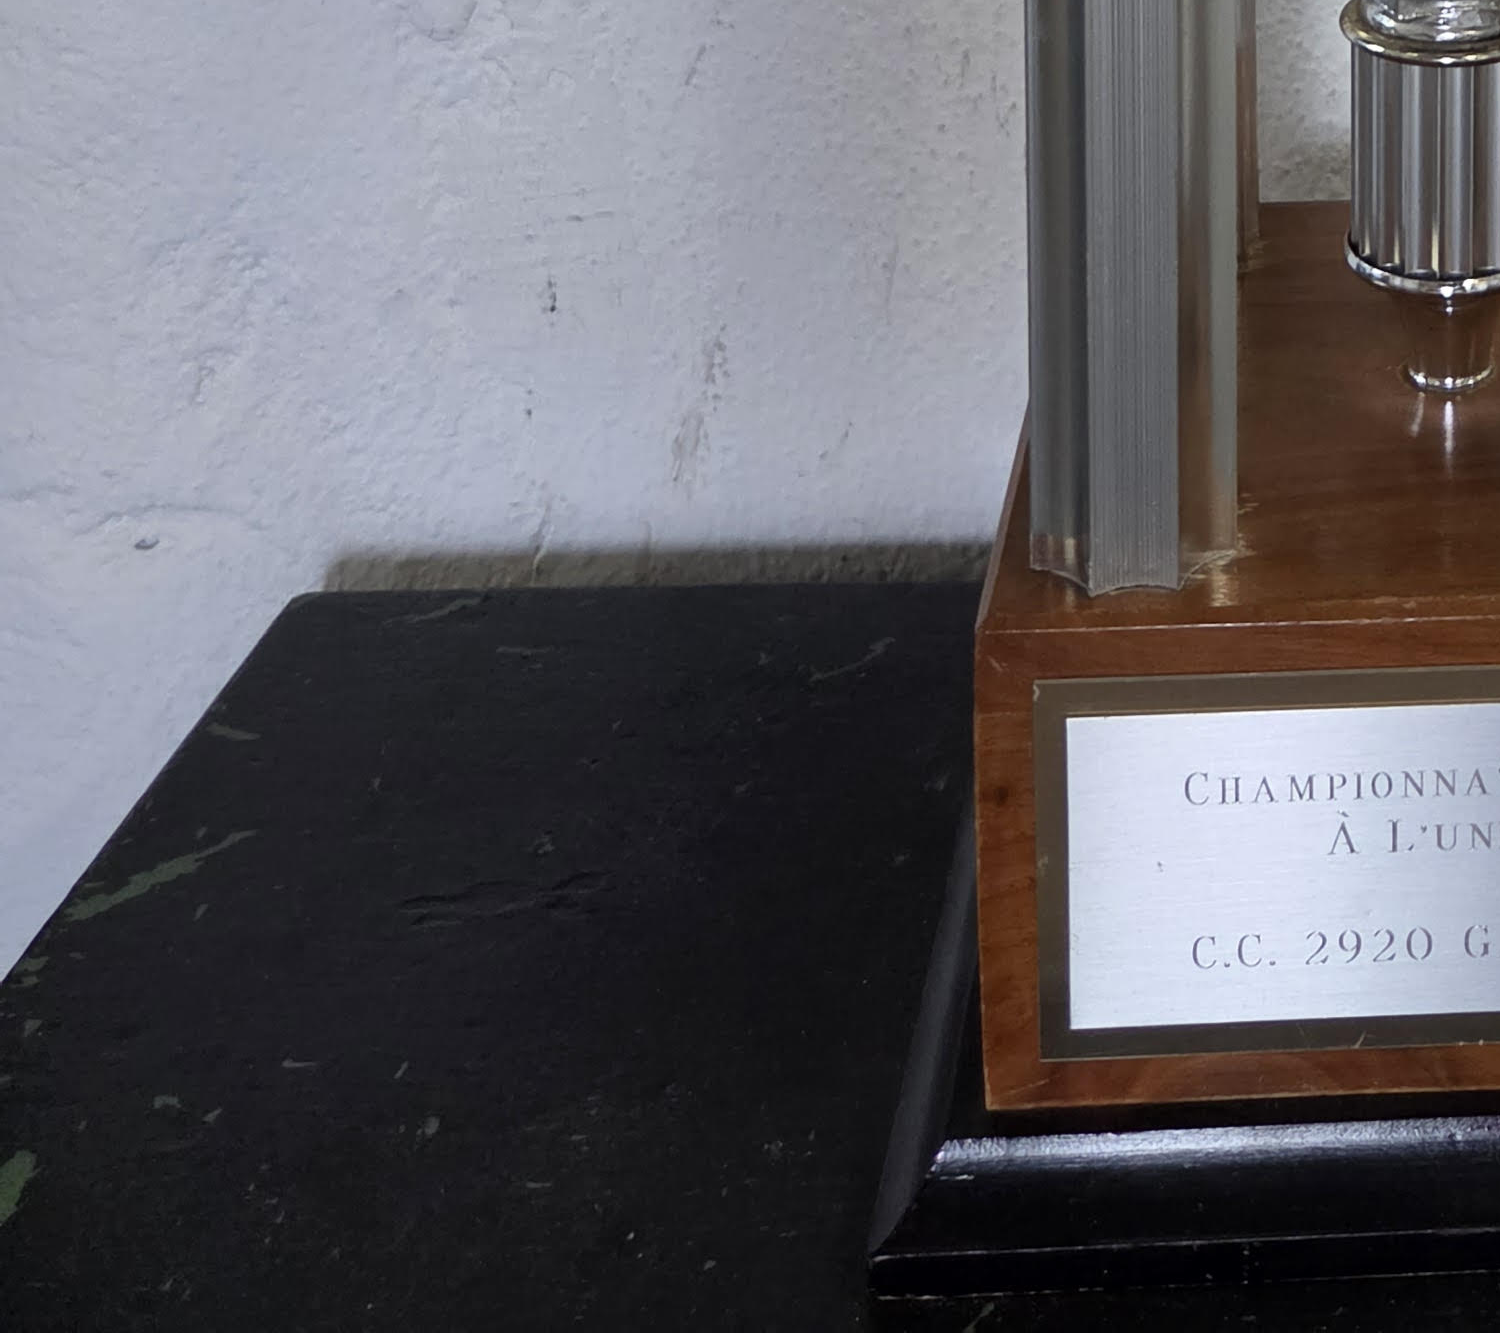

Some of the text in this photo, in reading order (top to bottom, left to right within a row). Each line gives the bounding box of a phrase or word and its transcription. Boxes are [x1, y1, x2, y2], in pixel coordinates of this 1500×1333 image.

[1327, 810, 1358, 855] À
[1191, 933, 1277, 970] C.C.
[1304, 925, 1434, 966] 2920
